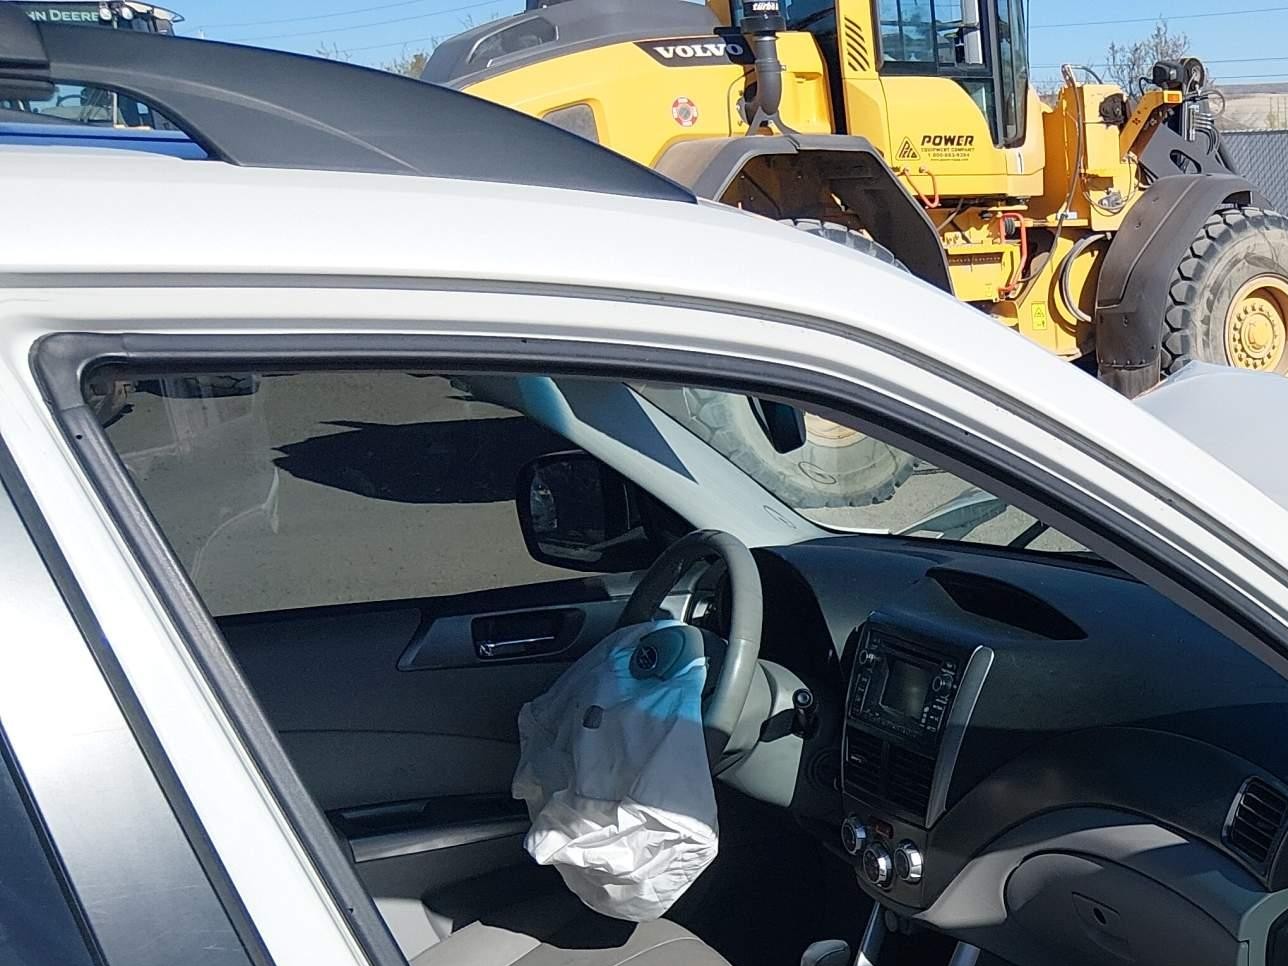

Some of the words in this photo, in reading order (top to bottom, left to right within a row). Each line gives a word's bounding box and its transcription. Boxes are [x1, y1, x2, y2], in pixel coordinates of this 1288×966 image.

[49, 9, 99, 22] DEERE
[653, 43, 744, 58] VOLVO
[920, 135, 975, 147] POWER
